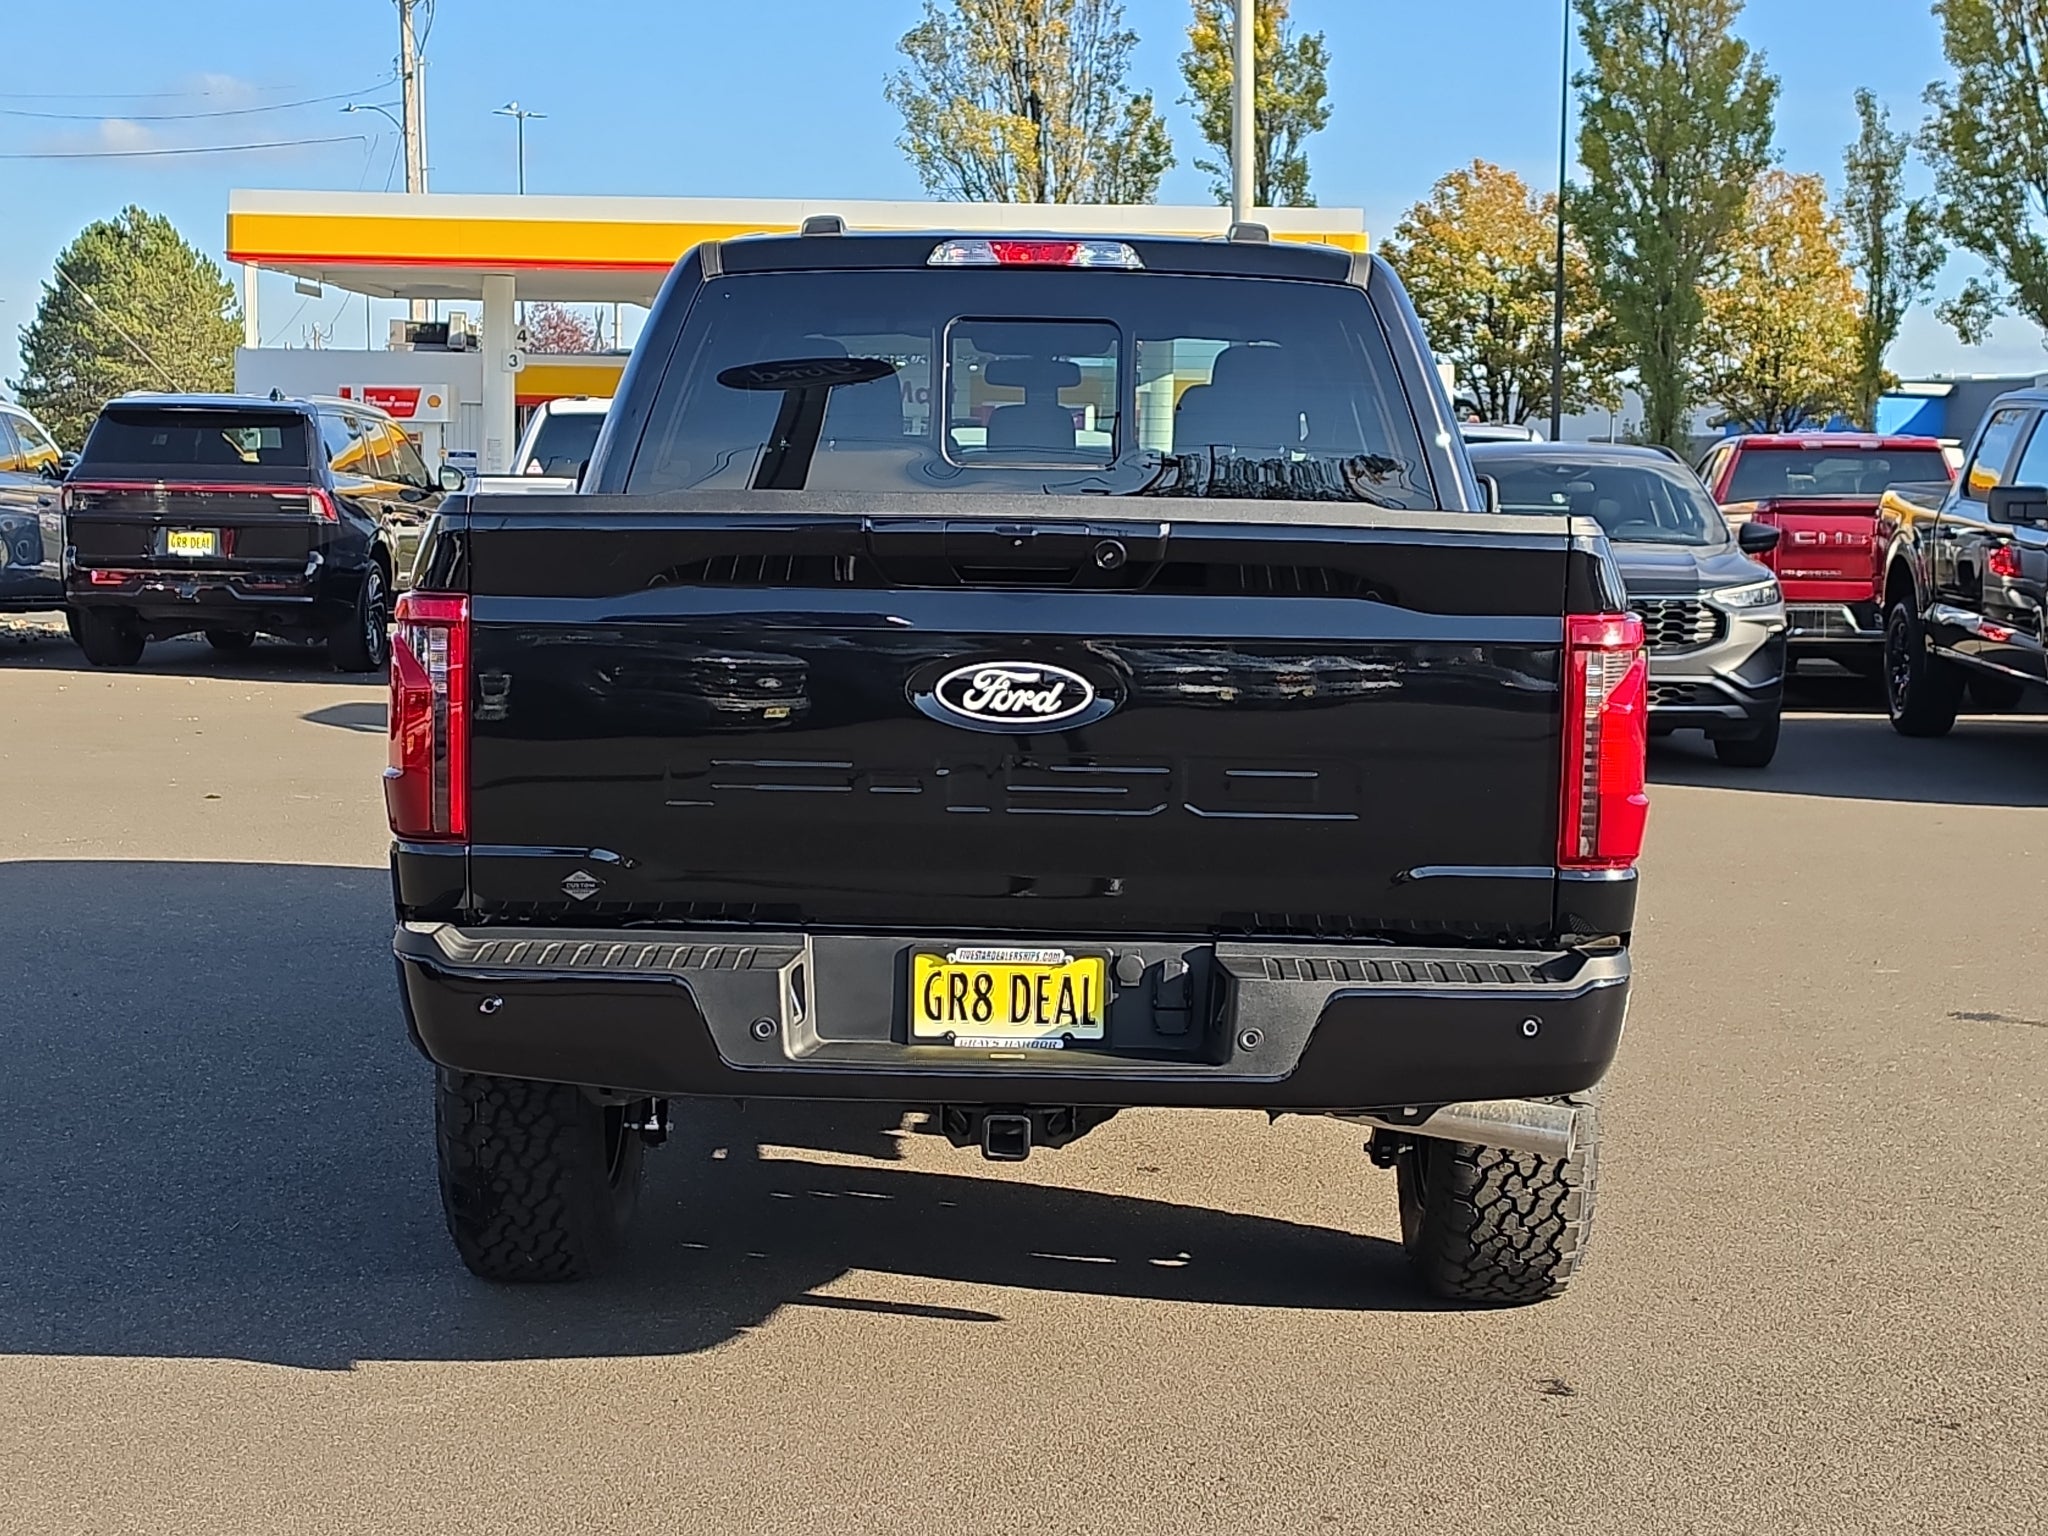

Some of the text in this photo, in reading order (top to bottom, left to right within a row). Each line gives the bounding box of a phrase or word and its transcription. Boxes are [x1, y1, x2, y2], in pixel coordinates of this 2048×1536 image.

[516, 329, 528, 343] 4
[508, 353, 519, 368] 3
[170, 535, 210, 550] GR8 DEAL
[962, 668, 1066, 713] Ford
[923, 971, 1098, 1027] GR8 DEAL
[959, 1039, 1058, 1049] GRAYS HARBOR
